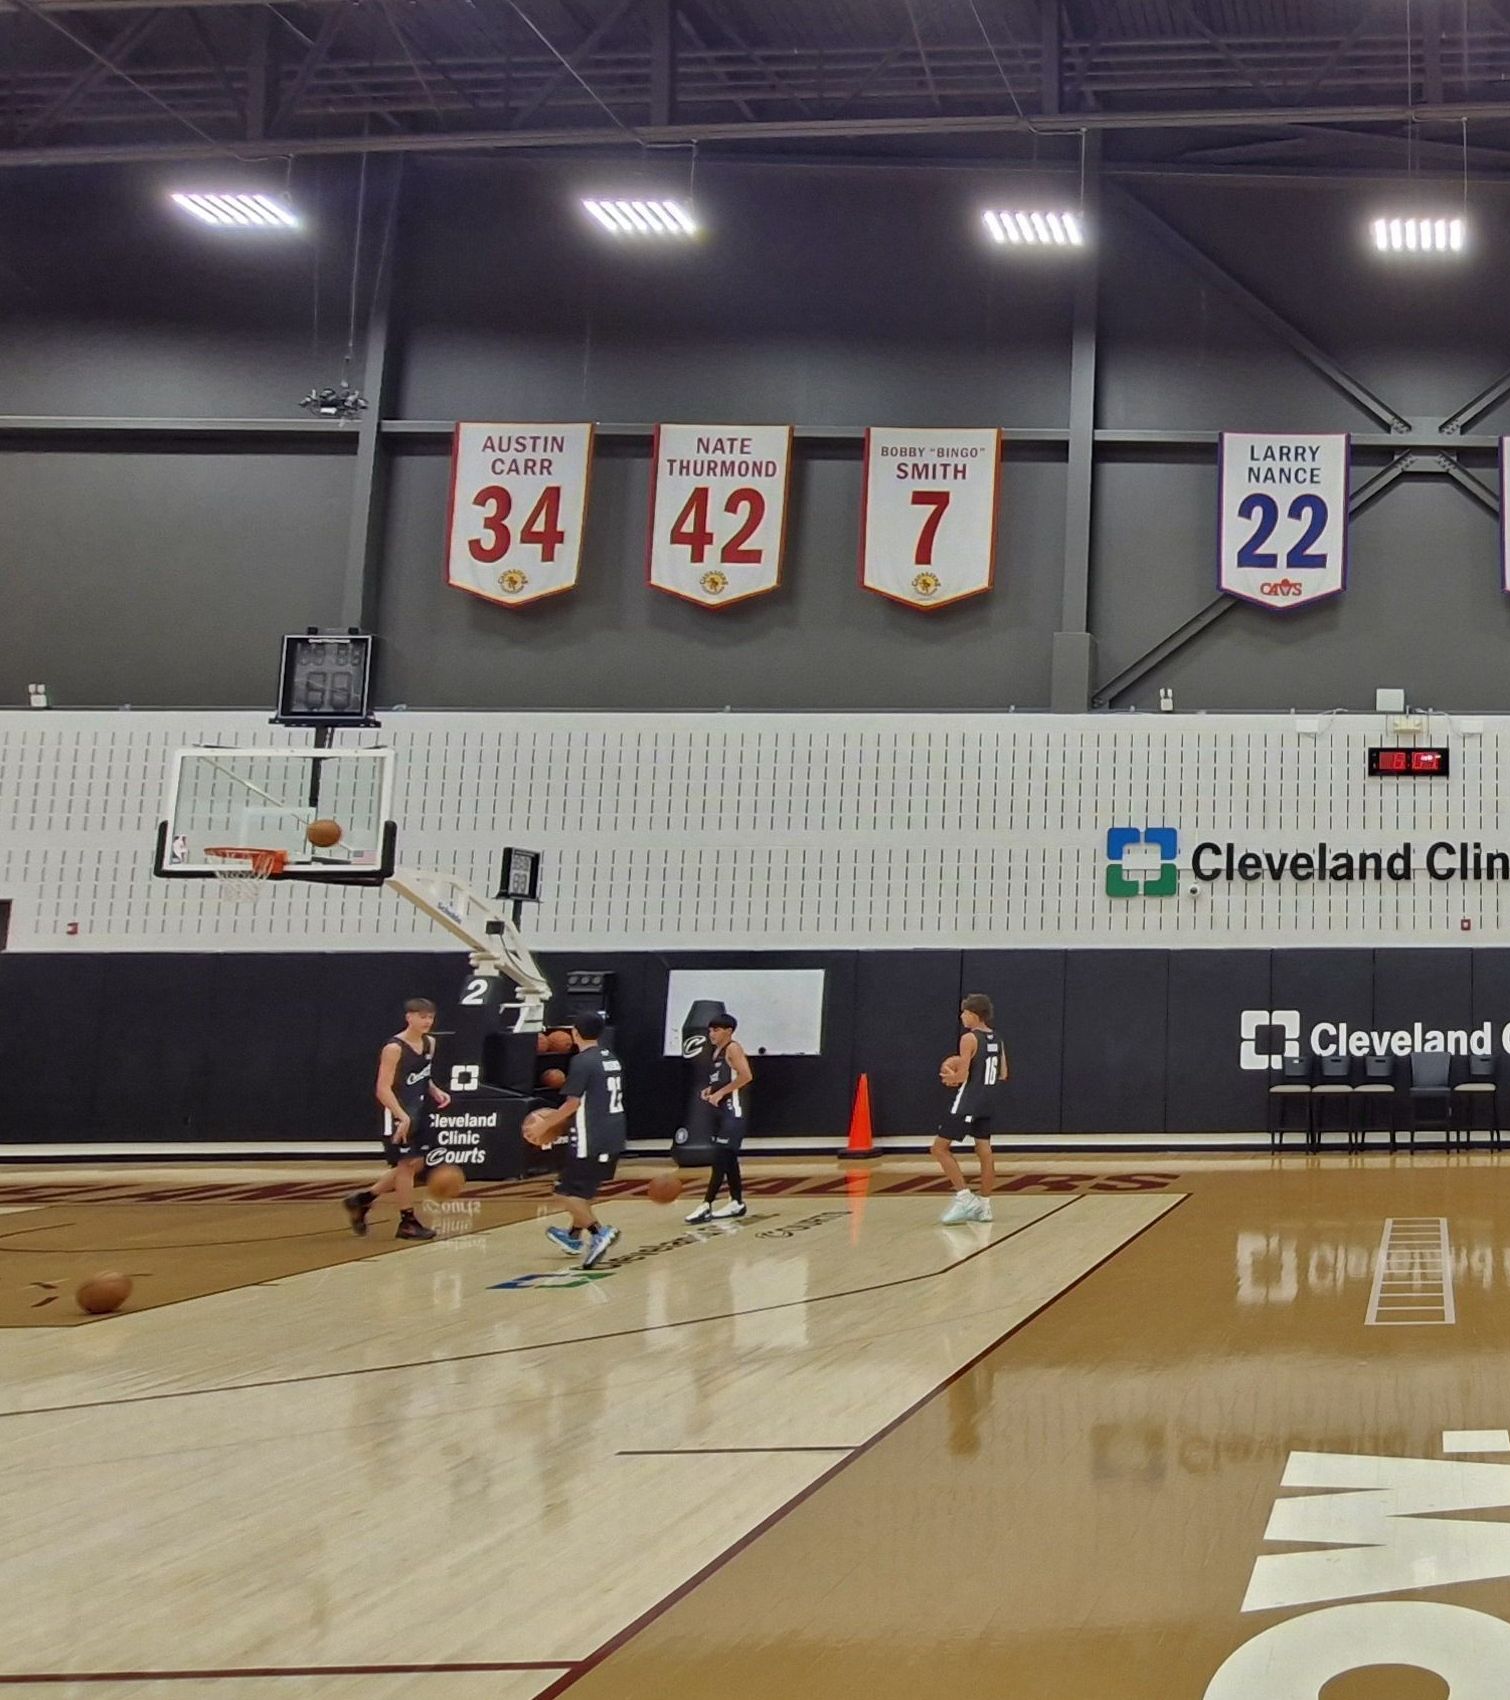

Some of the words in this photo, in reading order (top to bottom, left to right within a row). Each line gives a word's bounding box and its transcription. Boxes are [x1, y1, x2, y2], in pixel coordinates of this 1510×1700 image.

[482, 435, 565, 454] AUSTIN
[696, 437, 753, 455] NATE
[880, 446, 926, 458] BOBBY
[1250, 444, 1321, 462] LARRY
[491, 457, 553, 476] CARR
[666, 459, 777, 479] THURMOND
[896, 462, 967, 481] SMITH
[1247, 467, 1321, 485] NANCE
[467, 485, 565, 564] 34
[669, 486, 767, 564] 42
[910, 490, 951, 566] 7
[1236, 493, 1329, 569] 22
[1259, 578, 1303, 597] CAVS
[1191, 842, 1412, 882] Cleveland
[461, 978, 489, 1006] 2
[1310, 1021, 1493, 1057] Cleveland
[984, 1055, 999, 1086] 16
[437, 1130, 481, 1146] Clinic
[425, 1146, 487, 1167] Courts
